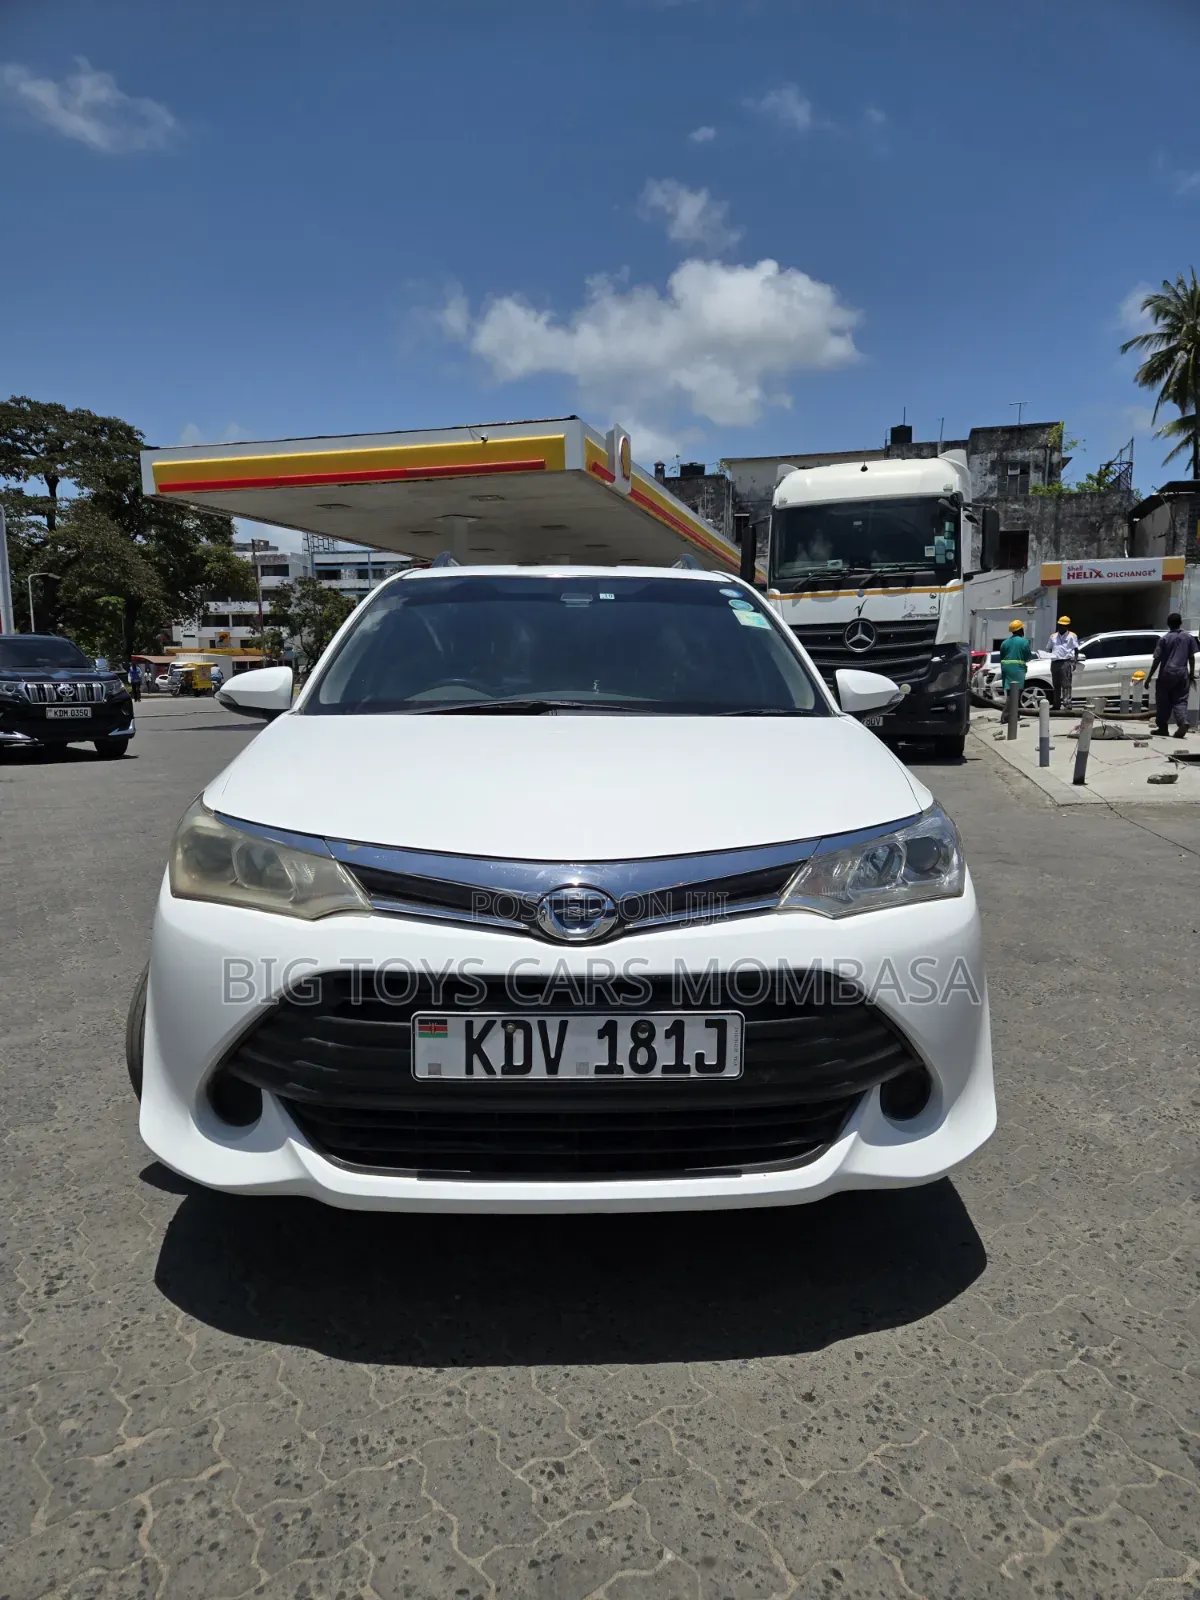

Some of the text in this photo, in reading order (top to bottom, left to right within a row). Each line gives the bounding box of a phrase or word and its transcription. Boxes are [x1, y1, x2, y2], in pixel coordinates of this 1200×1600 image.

[1066, 567, 1105, 580] HELIX
[464, 1019, 569, 1076] KDV
[594, 1018, 728, 1076] 181J
